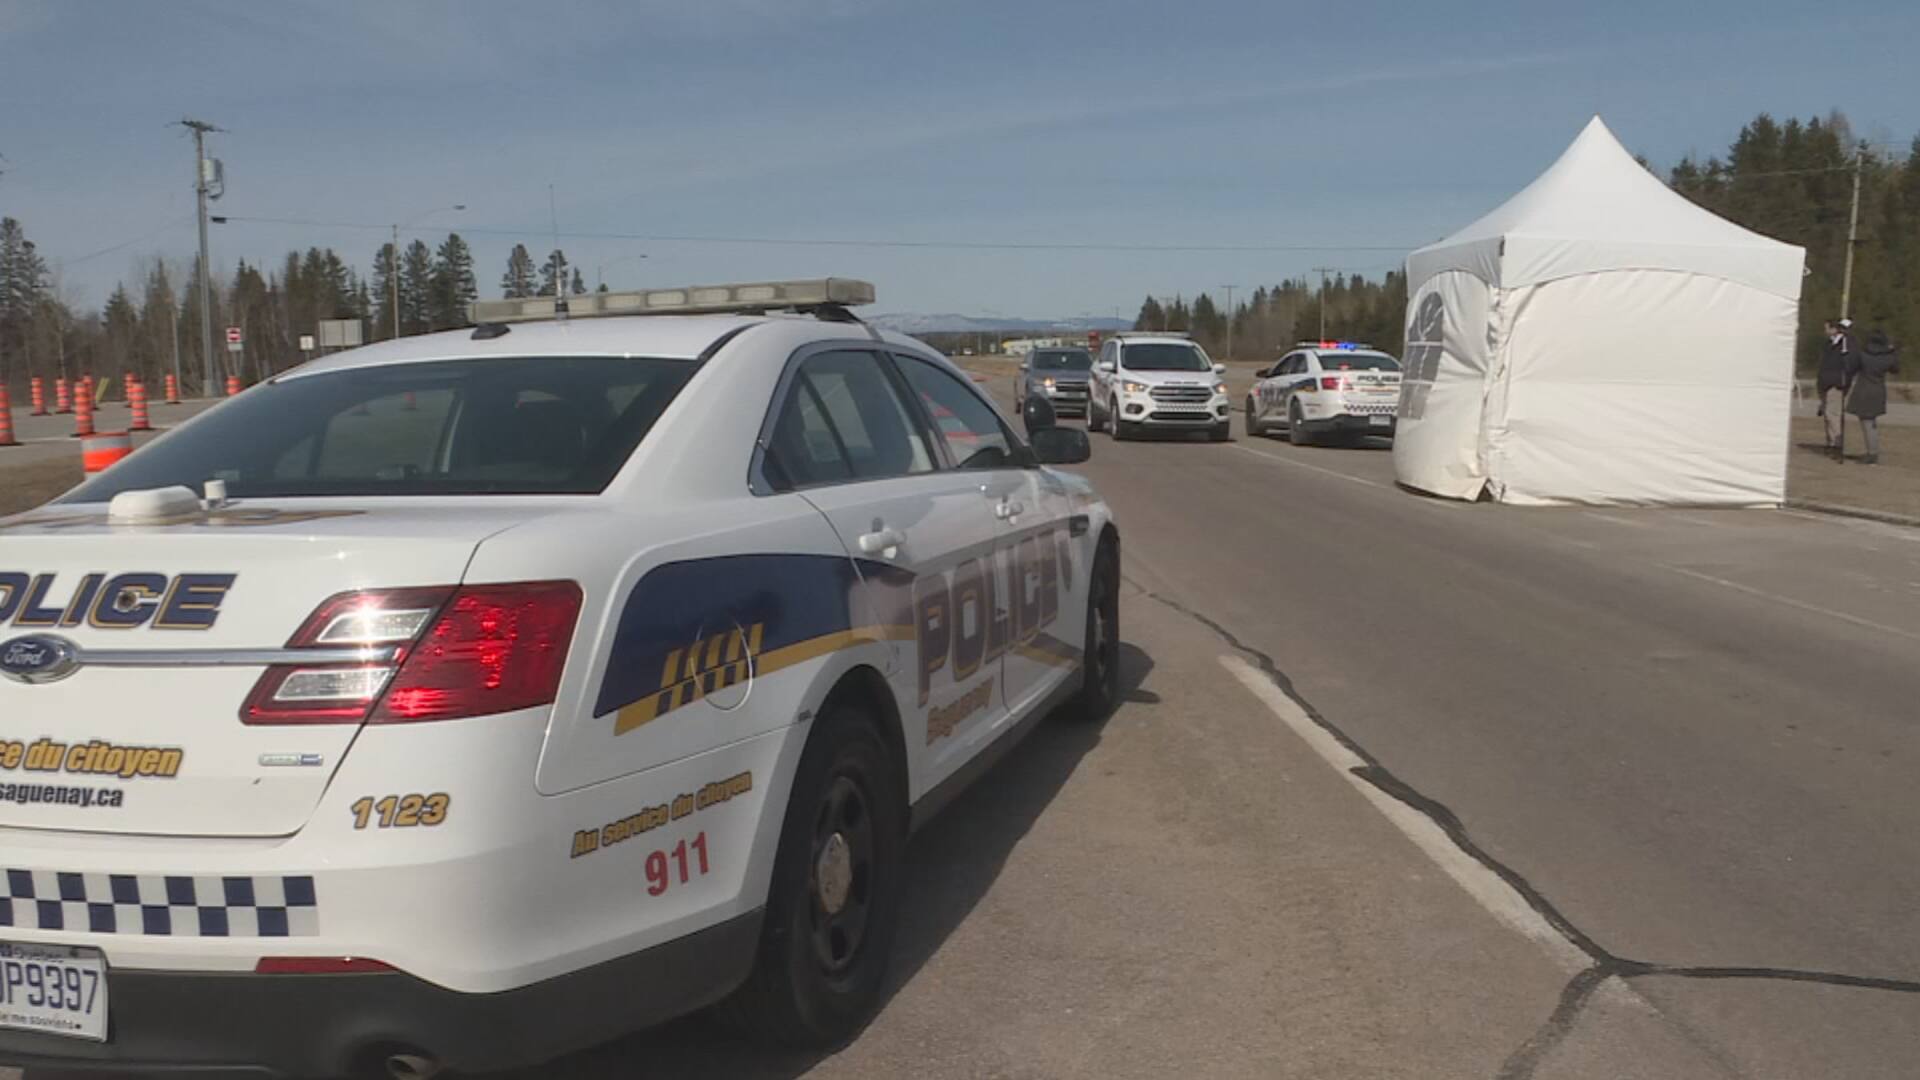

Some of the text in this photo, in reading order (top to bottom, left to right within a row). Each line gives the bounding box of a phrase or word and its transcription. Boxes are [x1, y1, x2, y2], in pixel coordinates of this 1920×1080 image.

[911, 529, 1058, 709] POLICE
[4, 642, 46, 666] Ford
[24, 738, 67, 771] du
[66, 740, 183, 778] citoyen
[351, 792, 450, 829] 1123
[570, 771, 752, 859] Au service du citoyen
[645, 831, 709, 896] 911
